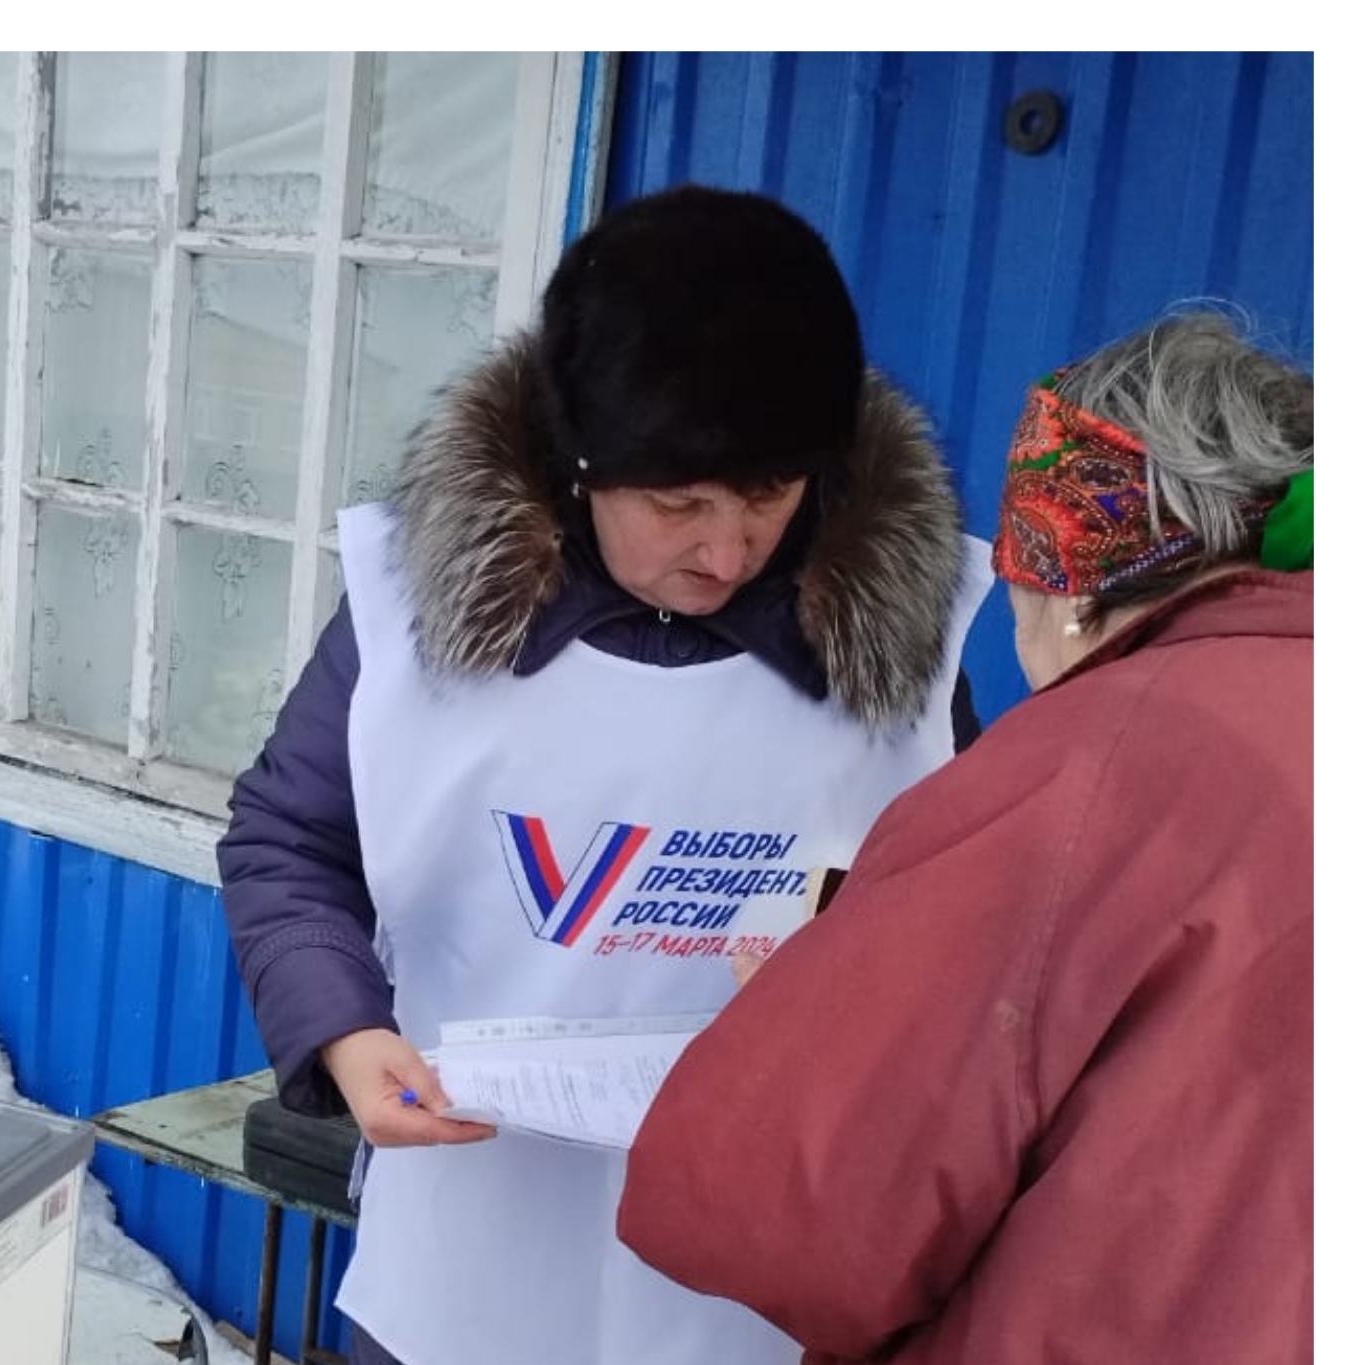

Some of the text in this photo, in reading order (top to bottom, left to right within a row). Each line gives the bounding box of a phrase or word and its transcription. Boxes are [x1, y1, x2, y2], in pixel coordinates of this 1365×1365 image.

[660, 830, 798, 860] ВЫБОРЫ
[613, 901, 740, 929] РОССИИ
[654, 934, 727, 957] МАРТА
